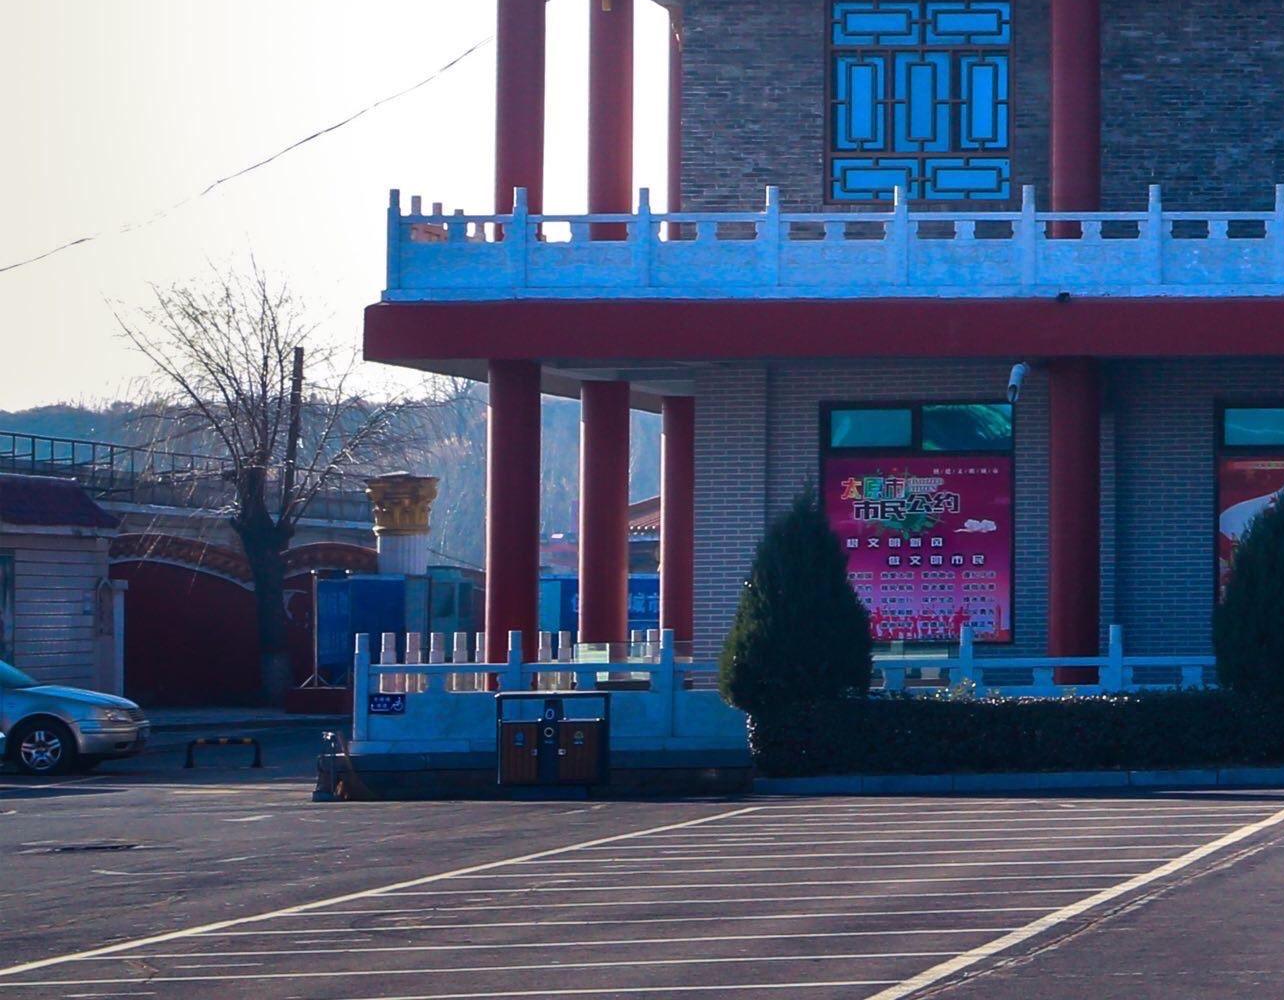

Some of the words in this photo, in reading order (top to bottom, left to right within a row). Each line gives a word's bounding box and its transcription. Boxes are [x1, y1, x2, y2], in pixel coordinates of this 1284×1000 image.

[841, 477, 905, 501] 太原市
[853, 490, 960, 521] 市民公约
